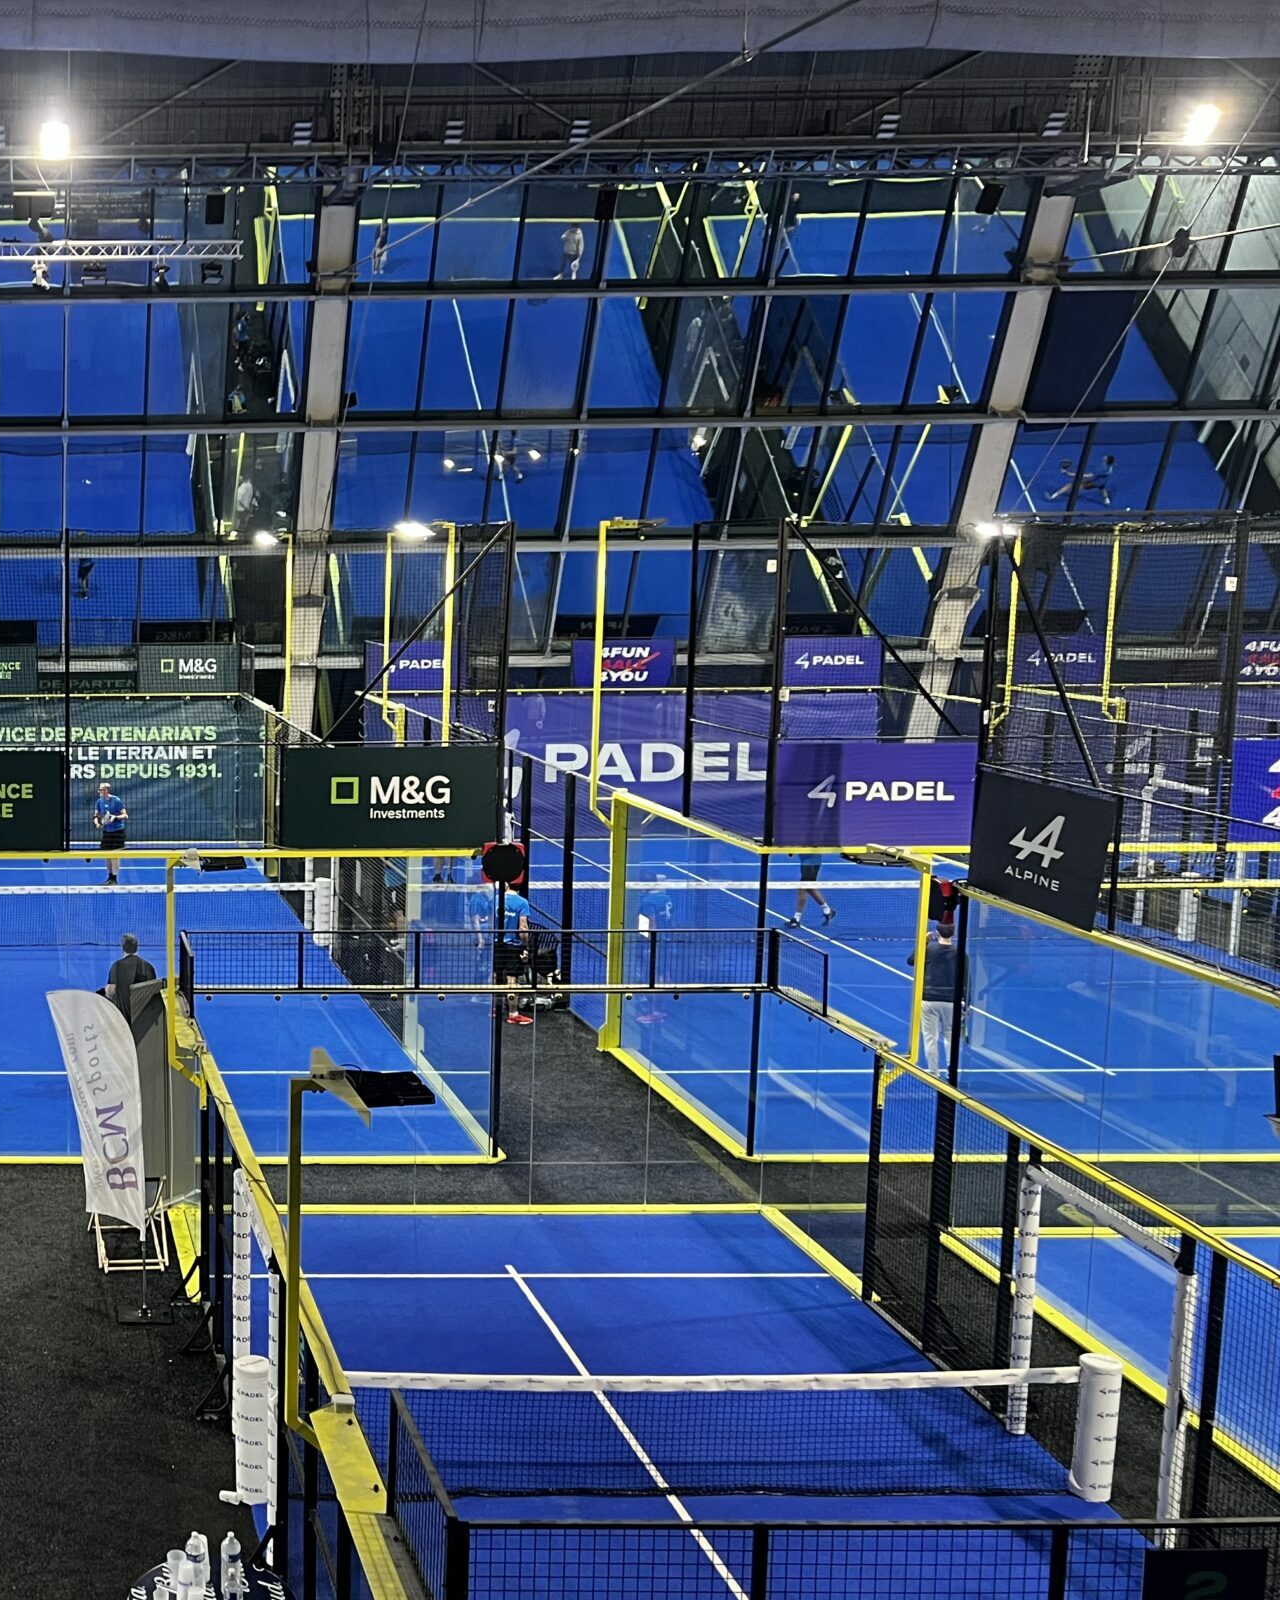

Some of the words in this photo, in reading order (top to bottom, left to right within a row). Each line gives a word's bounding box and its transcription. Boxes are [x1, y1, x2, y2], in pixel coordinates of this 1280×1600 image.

[1244, 641, 1280, 652] 4FU
[179, 658, 217, 673] M&G
[399, 659, 446, 670] PADE
[40, 726, 66, 742] DE
[70, 725, 218, 742] PARTENARIATS
[77, 747, 100, 761] LE
[106, 746, 185, 760] TERRAIN
[191, 745, 218, 759] ET
[99, 763, 171, 778] DEPUIS
[175, 762, 223, 778] 1931.
[369, 775, 451, 804] M&G
[369, 808, 446, 820] Investments
[1003, 864, 1061, 892] ALPINE
